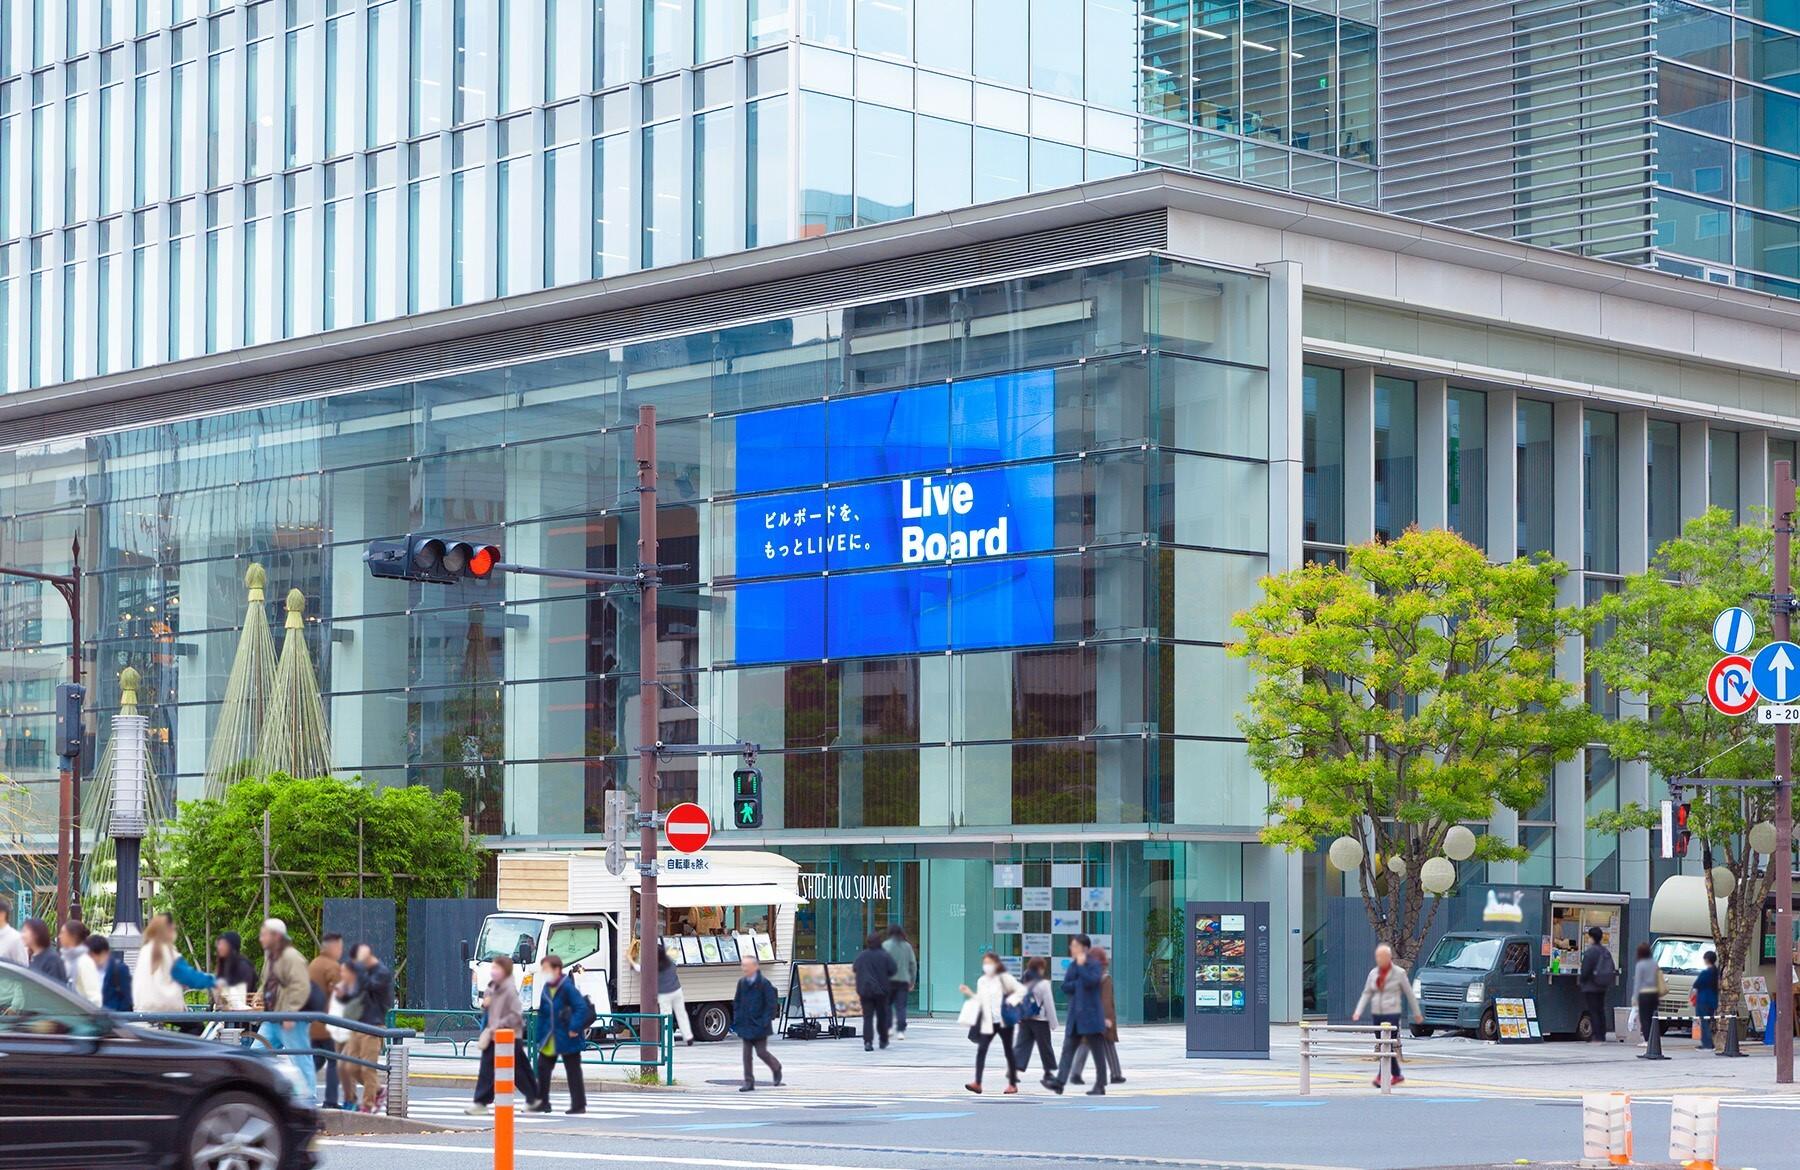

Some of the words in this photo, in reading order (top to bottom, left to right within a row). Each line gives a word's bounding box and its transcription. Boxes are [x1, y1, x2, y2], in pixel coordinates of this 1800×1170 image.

[902, 477, 974, 519] Live
[765, 503, 860, 529] ビルボードを、
[764, 533, 871, 559] もっとLIVEに。
[902, 517, 1008, 563] Board
[667, 858, 709, 870] 自転車を除く
[801, 875, 851, 900] SHOCHIKU
[853, 875, 892, 903] SQUARE
